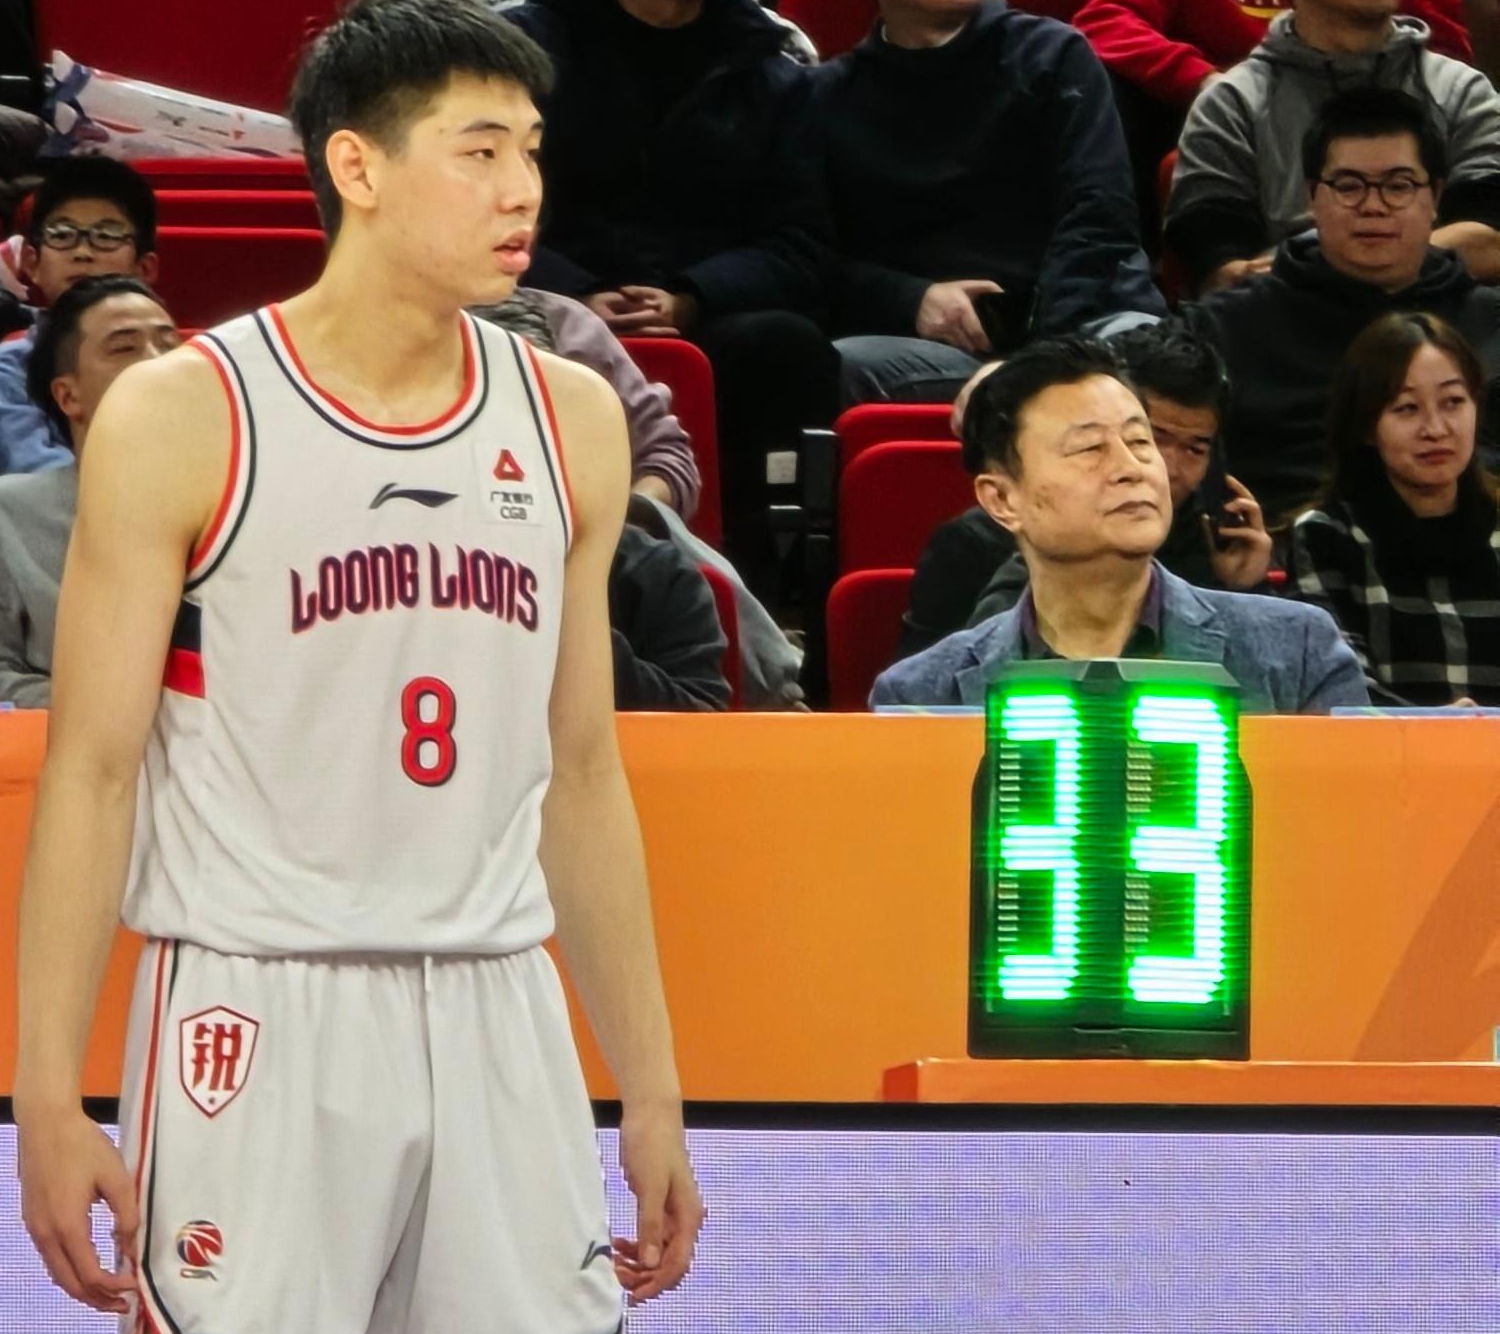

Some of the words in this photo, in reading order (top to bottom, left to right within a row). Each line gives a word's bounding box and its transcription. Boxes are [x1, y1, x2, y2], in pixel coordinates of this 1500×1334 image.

[290, 542, 420, 635] LOONG
[429, 541, 539, 634] LIONS
[401, 676, 457, 788] 8
[998, 693, 1229, 1005] 33
